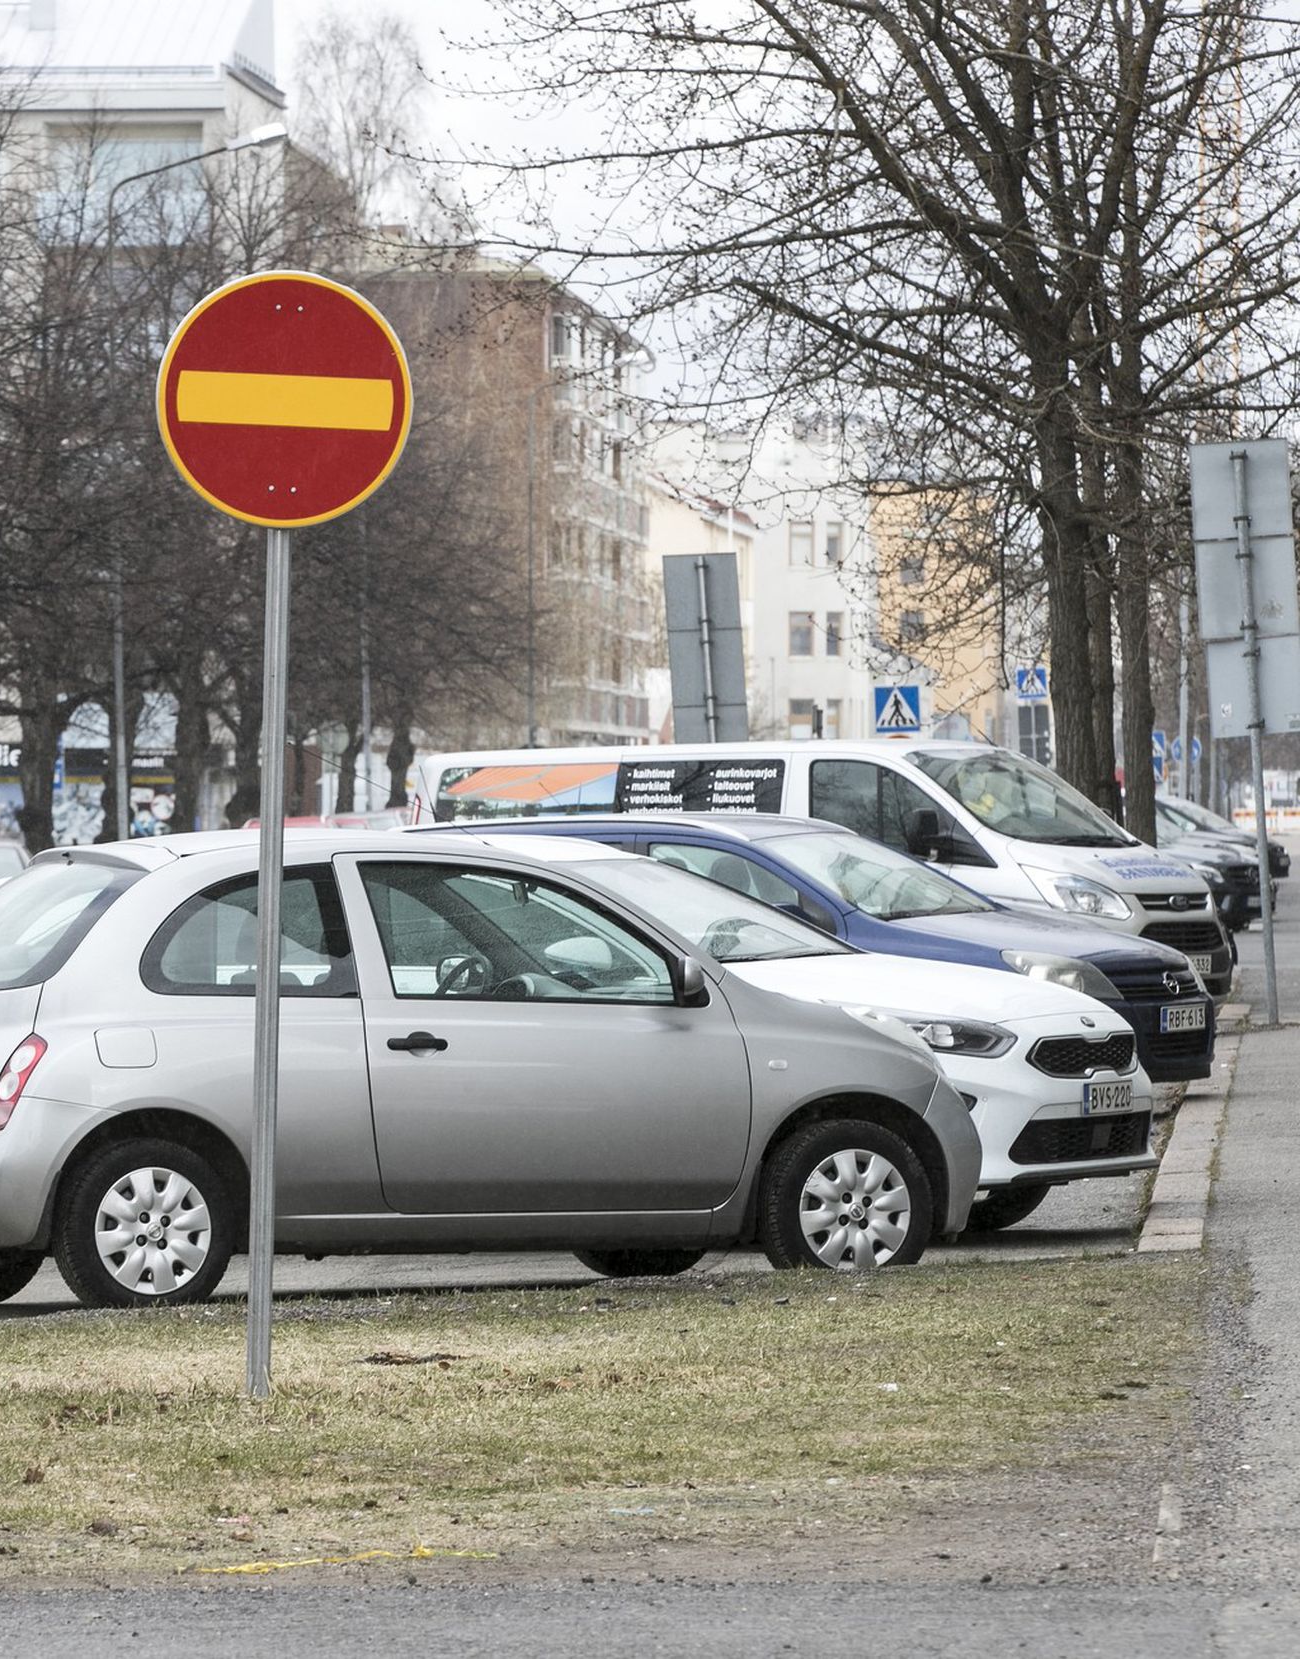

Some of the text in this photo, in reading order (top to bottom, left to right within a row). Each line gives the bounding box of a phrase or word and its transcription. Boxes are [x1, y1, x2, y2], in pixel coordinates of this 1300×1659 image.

[715, 768, 777, 780] aurinkovarjot
[630, 794, 683, 804] verhokiskot
[712, 793, 755, 804] liukuovet
[1168, 1008, 1205, 1029] RBF-613
[1091, 1085, 1131, 1110] BVS-220
